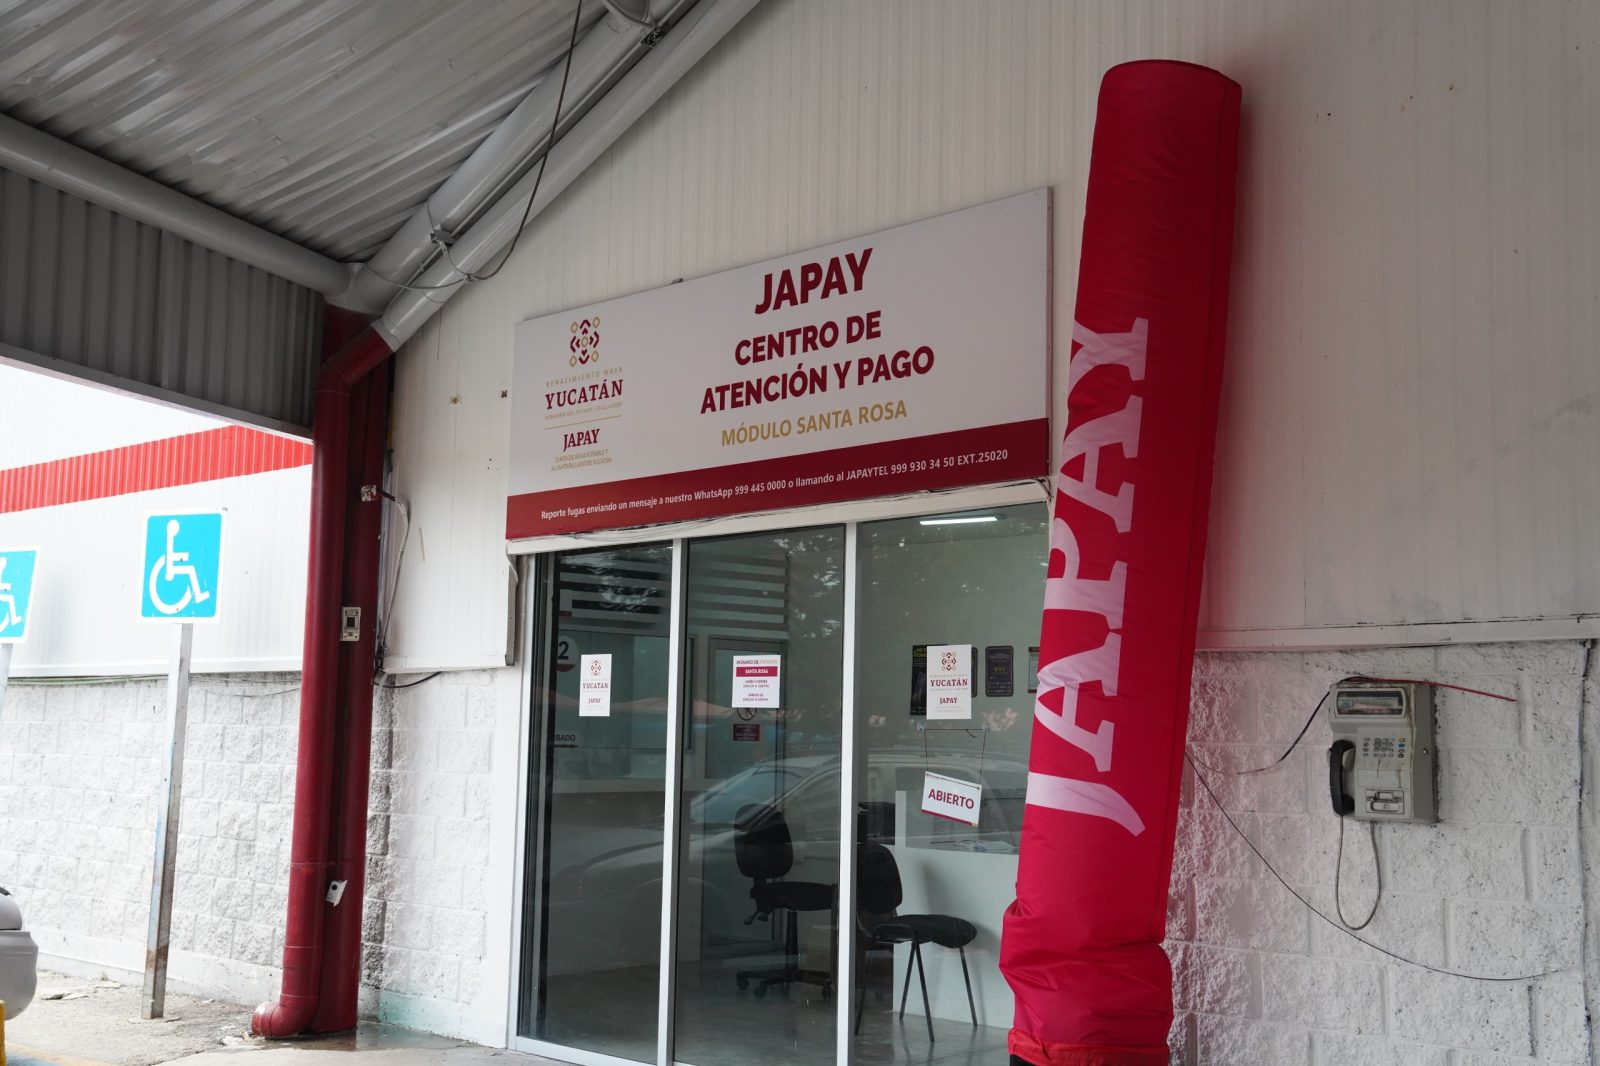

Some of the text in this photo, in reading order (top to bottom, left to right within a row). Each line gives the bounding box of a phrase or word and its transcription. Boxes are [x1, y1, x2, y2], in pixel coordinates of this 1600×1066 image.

[754, 248, 873, 315] JAPAY
[735, 310, 881, 366] CENTRO DE
[545, 379, 623, 409] YUCATÁN
[700, 346, 934, 414] ATENCIÓN Y PAGO
[563, 428, 600, 452] JAPAY
[722, 400, 908, 447] MÓDULO SANTA ROSA
[541, 510, 566, 520] Reporte
[567, 507, 585, 518] fugas
[586, 503, 617, 514] enviando
[618, 502, 627, 510] un
[629, 497, 658, 509] mensaje
[665, 493, 693, 504] nuestro
[694, 488, 733, 501] WhatsApp
[735, 485, 749, 495] 999
[750, 483, 765, 493] 445
[767, 480, 786, 490] 0000
[796, 473, 834, 486] llamando
[836, 472, 844, 481] al
[846, 466, 888, 480] JAPAYTEL
[891, 463, 907, 475] 999
[910, 460, 926, 472] 930
[929, 459, 940, 470] 34
[943, 457, 954, 467] 50
[957, 449, 1008, 466] EXT.25020
[1025, 317, 1148, 838] JAPAY
[930, 678, 968, 687] YUCATÁN
[939, 697, 958, 705] JAPAY
[928, 788, 975, 810] ABIERTO
